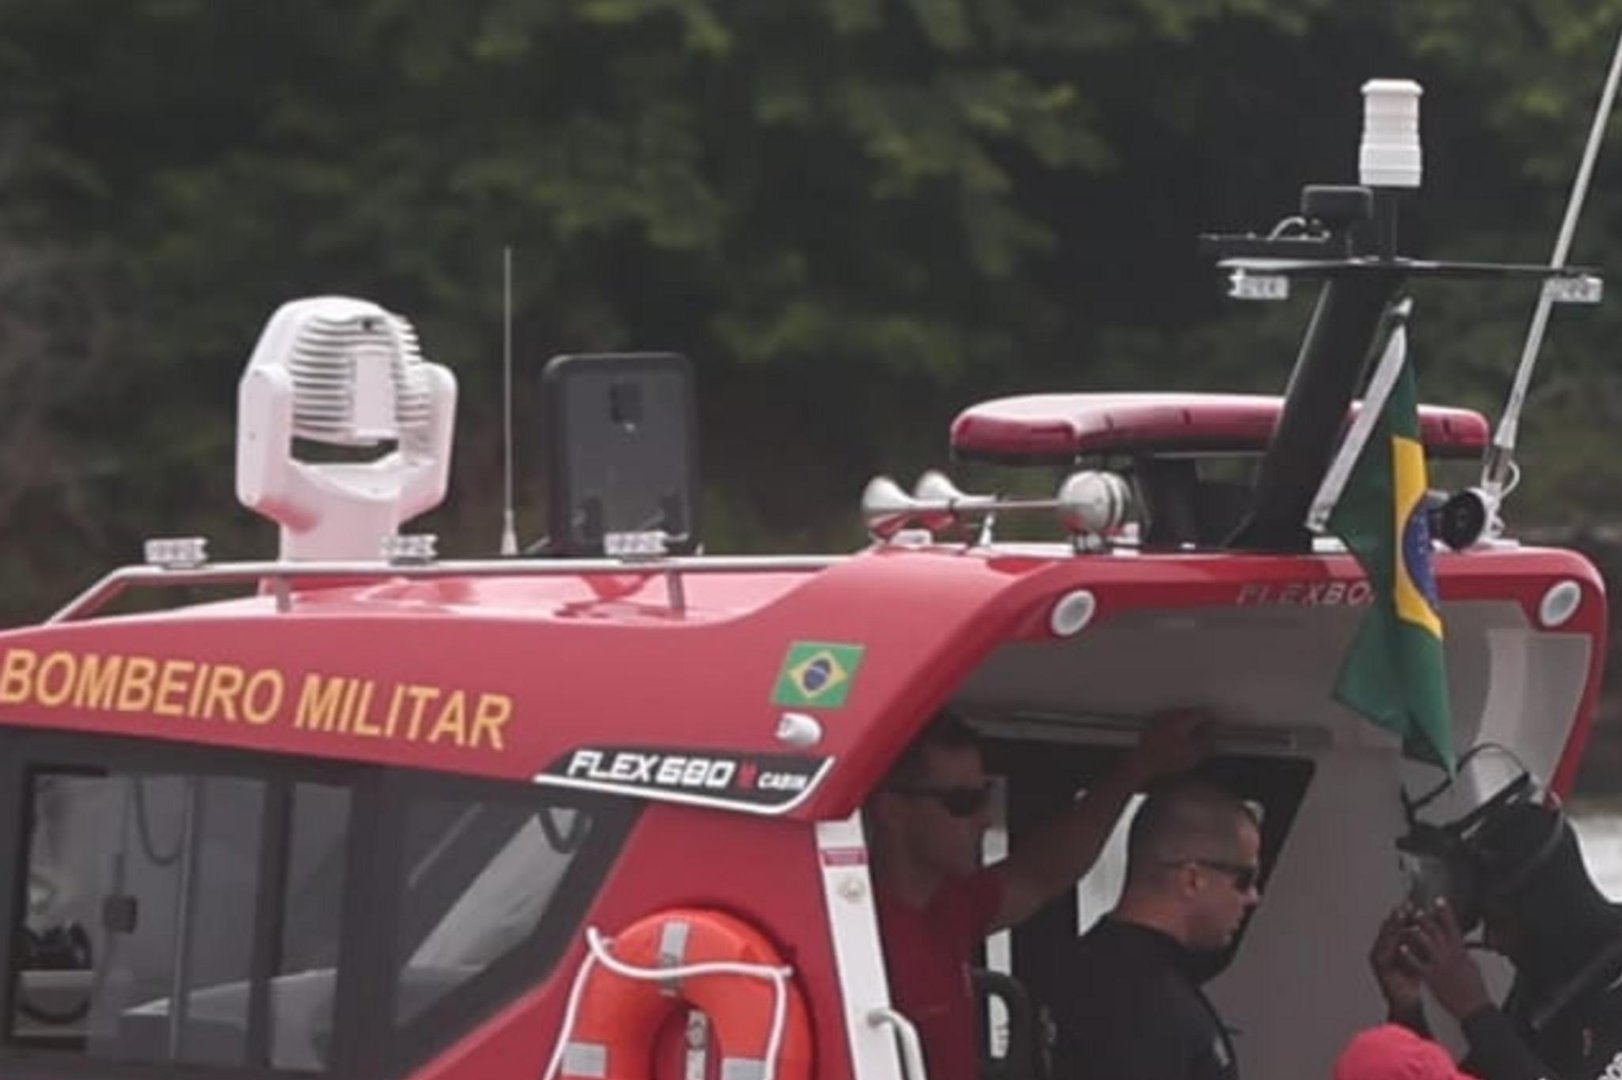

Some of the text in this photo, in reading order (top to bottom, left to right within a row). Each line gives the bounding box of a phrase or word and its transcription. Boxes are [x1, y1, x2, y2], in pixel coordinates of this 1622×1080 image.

[1236, 580, 1374, 608] FLEXBO
[0, 648, 513, 751] BOMBEIRO MILITAR
